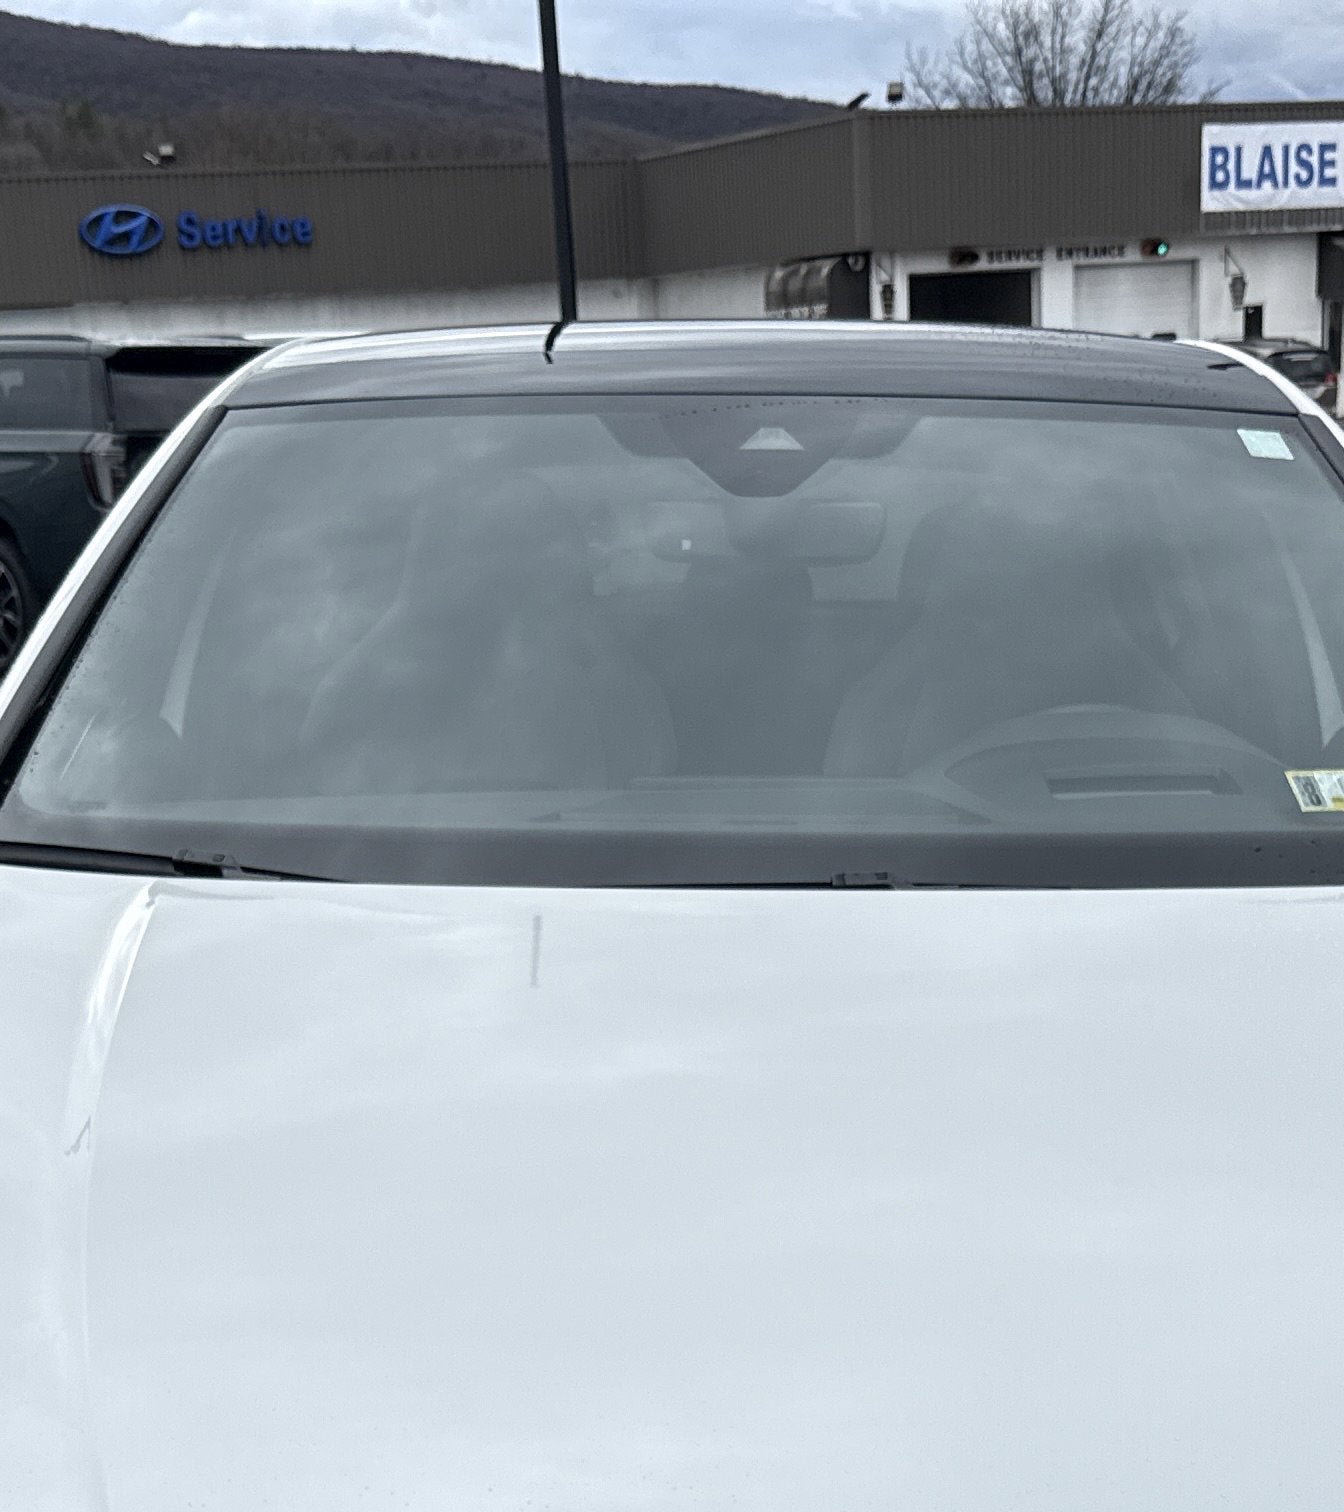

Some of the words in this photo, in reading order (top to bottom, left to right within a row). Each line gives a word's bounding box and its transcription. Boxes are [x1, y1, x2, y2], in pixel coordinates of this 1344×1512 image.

[1208, 142, 1338, 192] BLAISE
[177, 207, 313, 249] Service
[1306, 781, 1323, 808] 8
